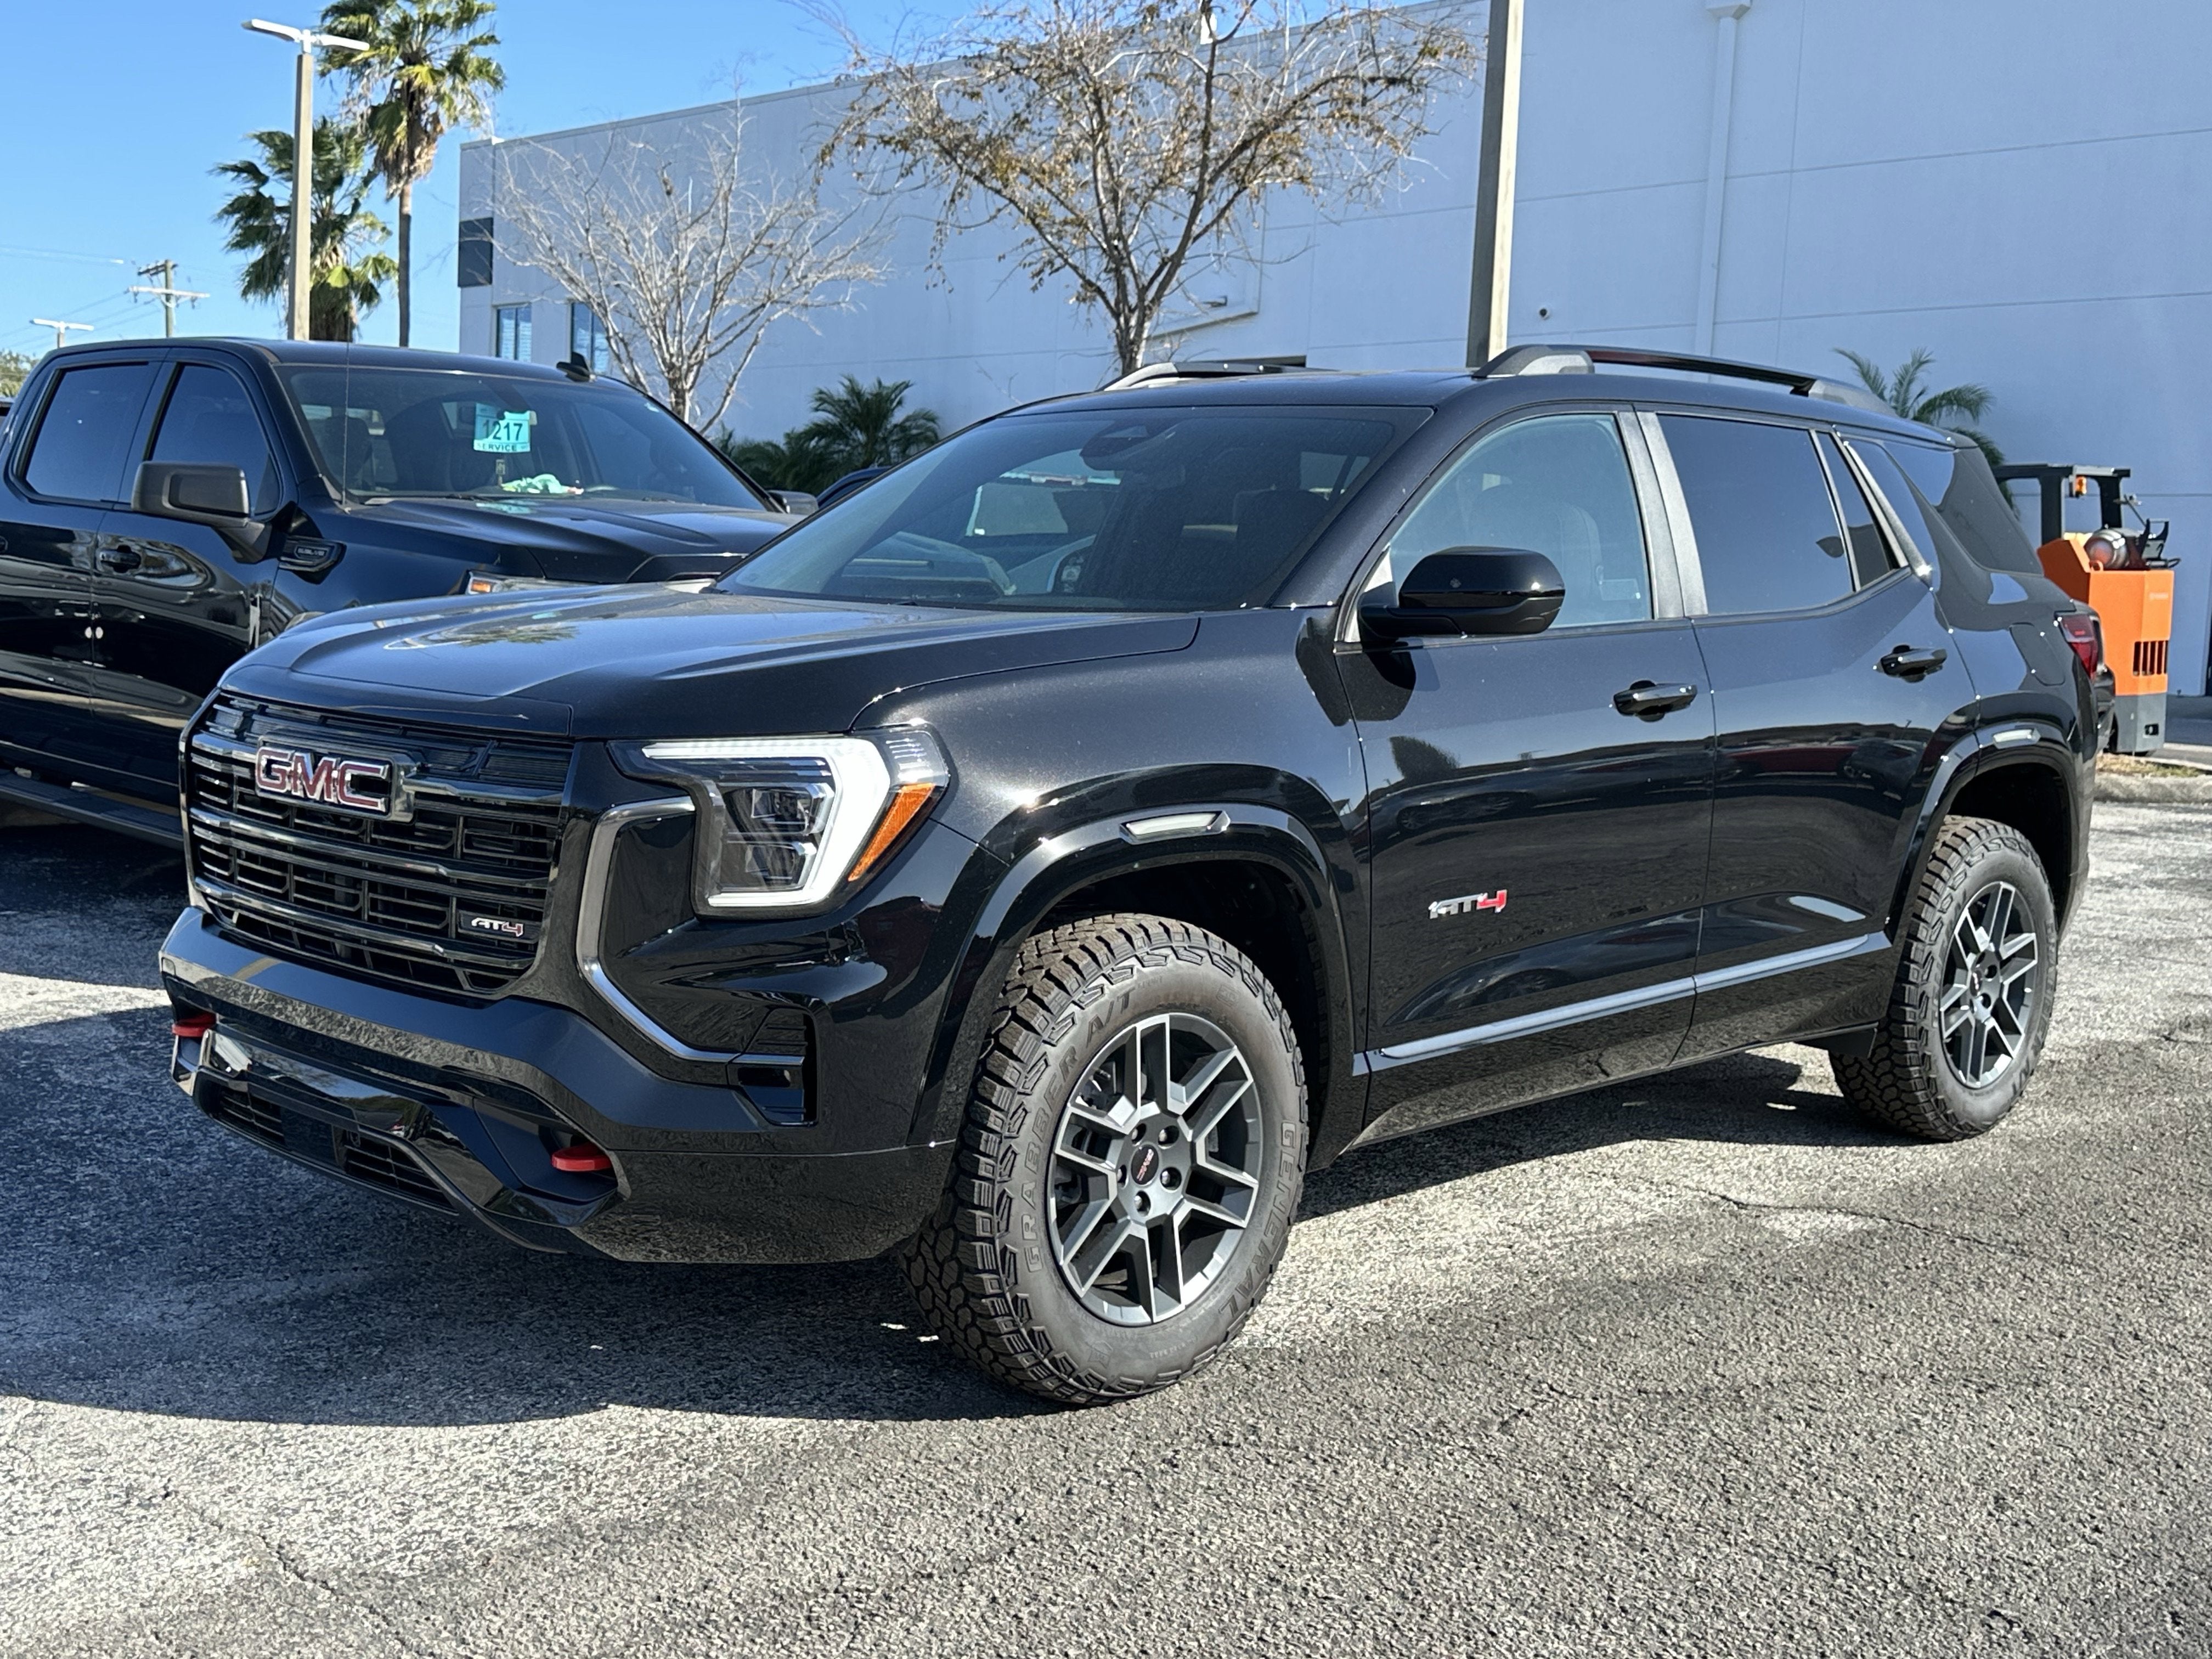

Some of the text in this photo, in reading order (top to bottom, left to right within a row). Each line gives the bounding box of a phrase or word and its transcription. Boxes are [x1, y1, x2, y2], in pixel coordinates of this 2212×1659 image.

[482, 419, 523, 441] 1217
[477, 443, 517, 452] SERVICE
[255, 746, 389, 812] GMC
[1428, 889, 1508, 919] AT4
[471, 917, 524, 938] AT4
[1020, 1045, 1078, 1273] GRABBER
[1218, 1121, 1297, 1319] GENERAL
